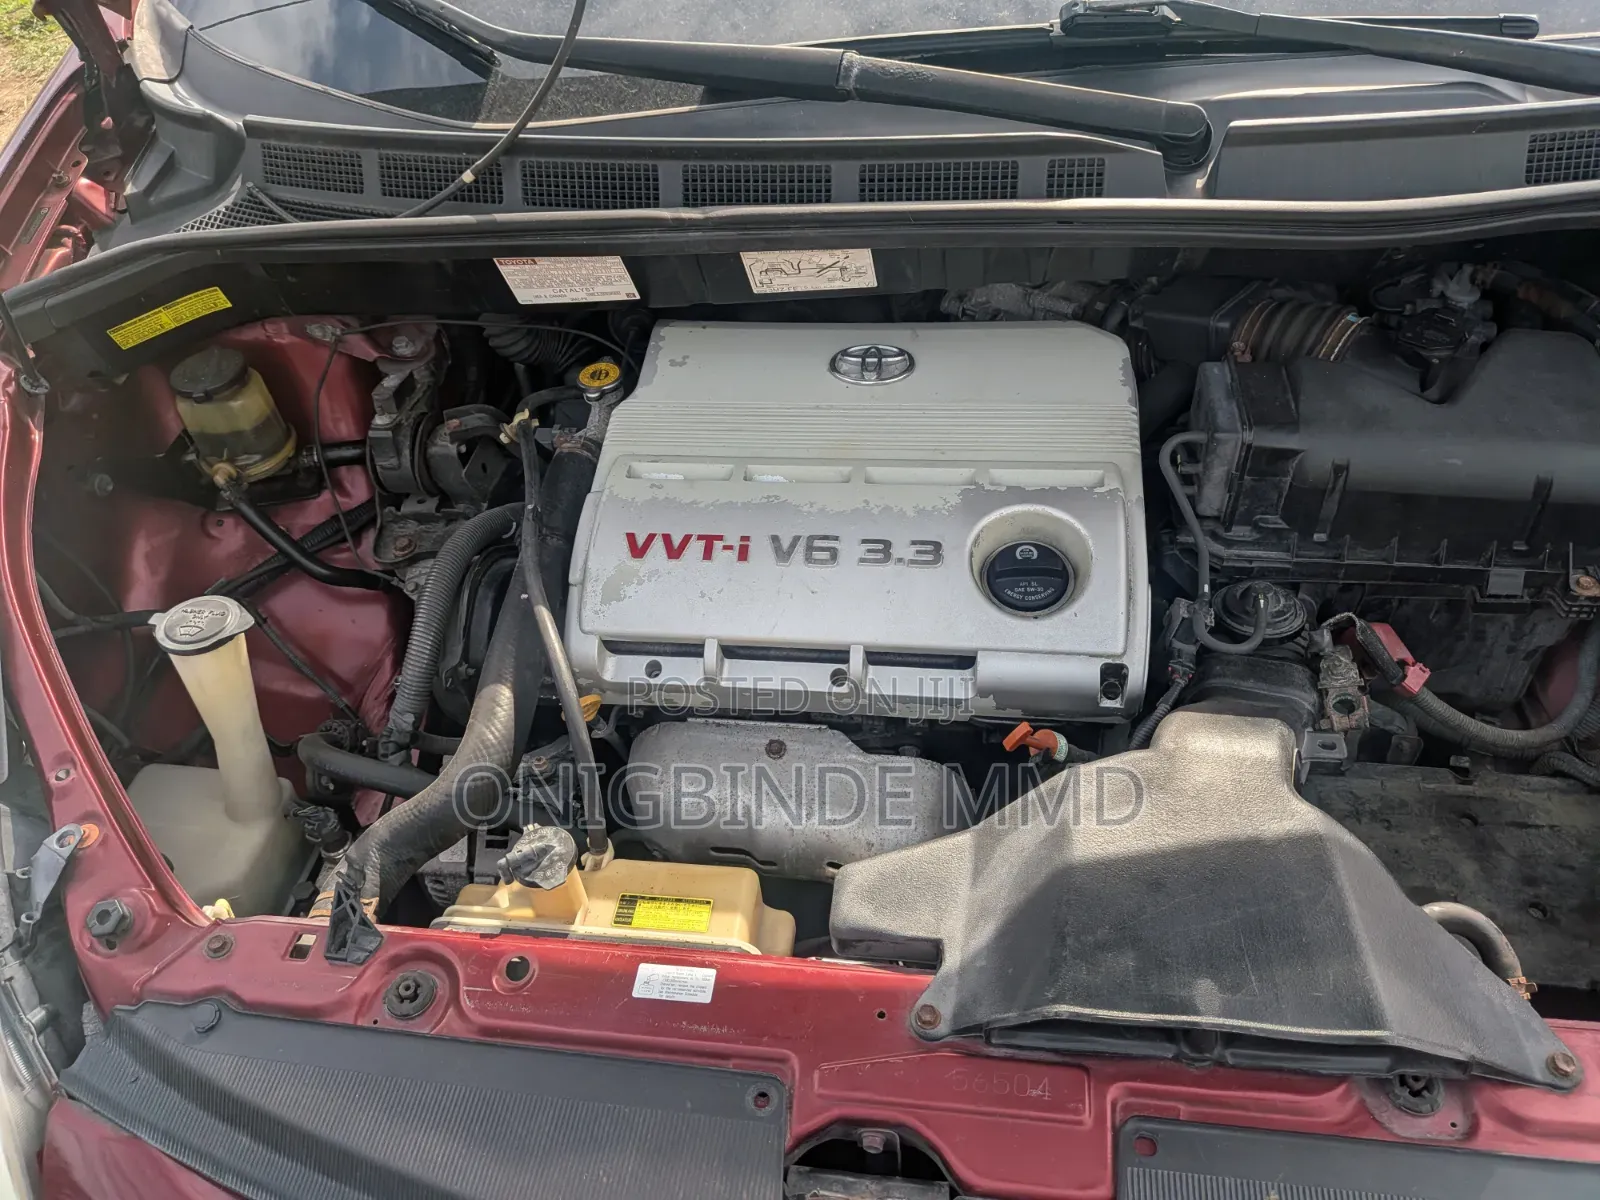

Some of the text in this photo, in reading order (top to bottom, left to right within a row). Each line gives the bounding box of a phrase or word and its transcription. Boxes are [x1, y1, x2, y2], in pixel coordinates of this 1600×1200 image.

[625, 532, 944, 568] VVT-i V6 3.3
